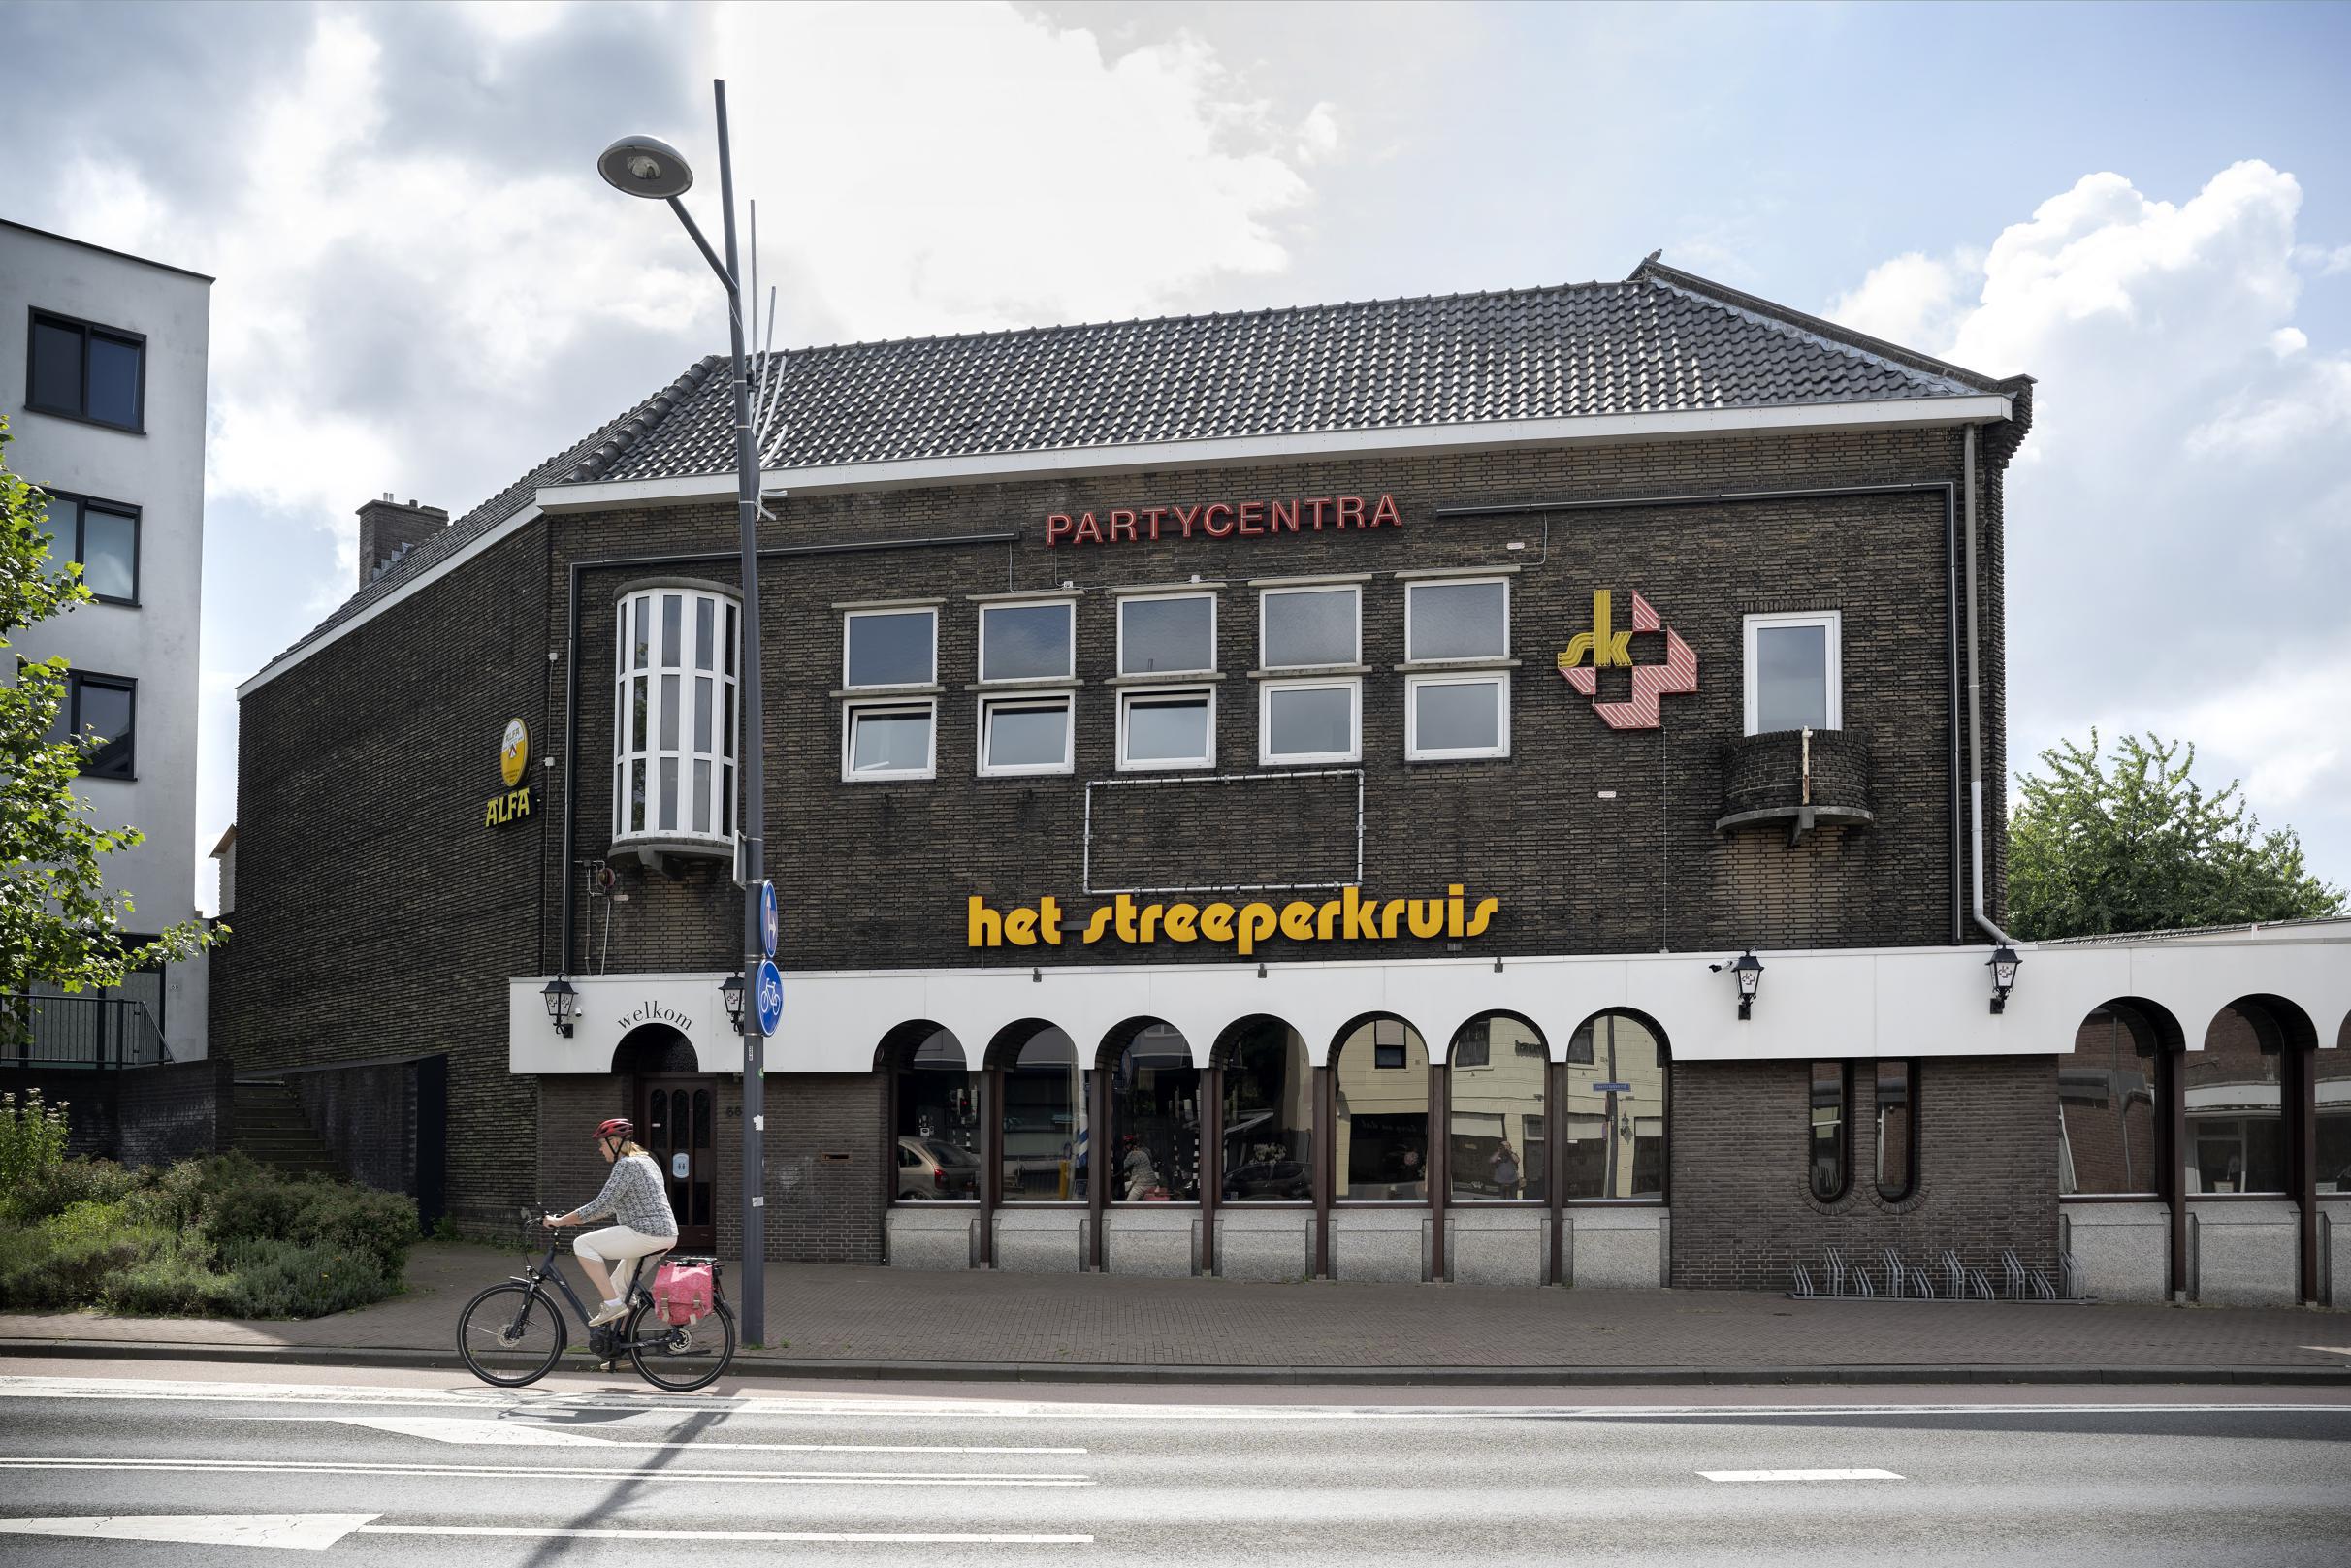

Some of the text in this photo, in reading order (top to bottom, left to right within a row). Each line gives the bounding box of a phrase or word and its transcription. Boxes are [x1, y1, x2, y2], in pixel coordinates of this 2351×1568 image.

[1047, 494, 1402, 546] PARTYCENTRA
[485, 787, 530, 827] ALFA
[968, 883, 1498, 955] het streeperkruis
[618, 1000, 692, 1031] welkom
